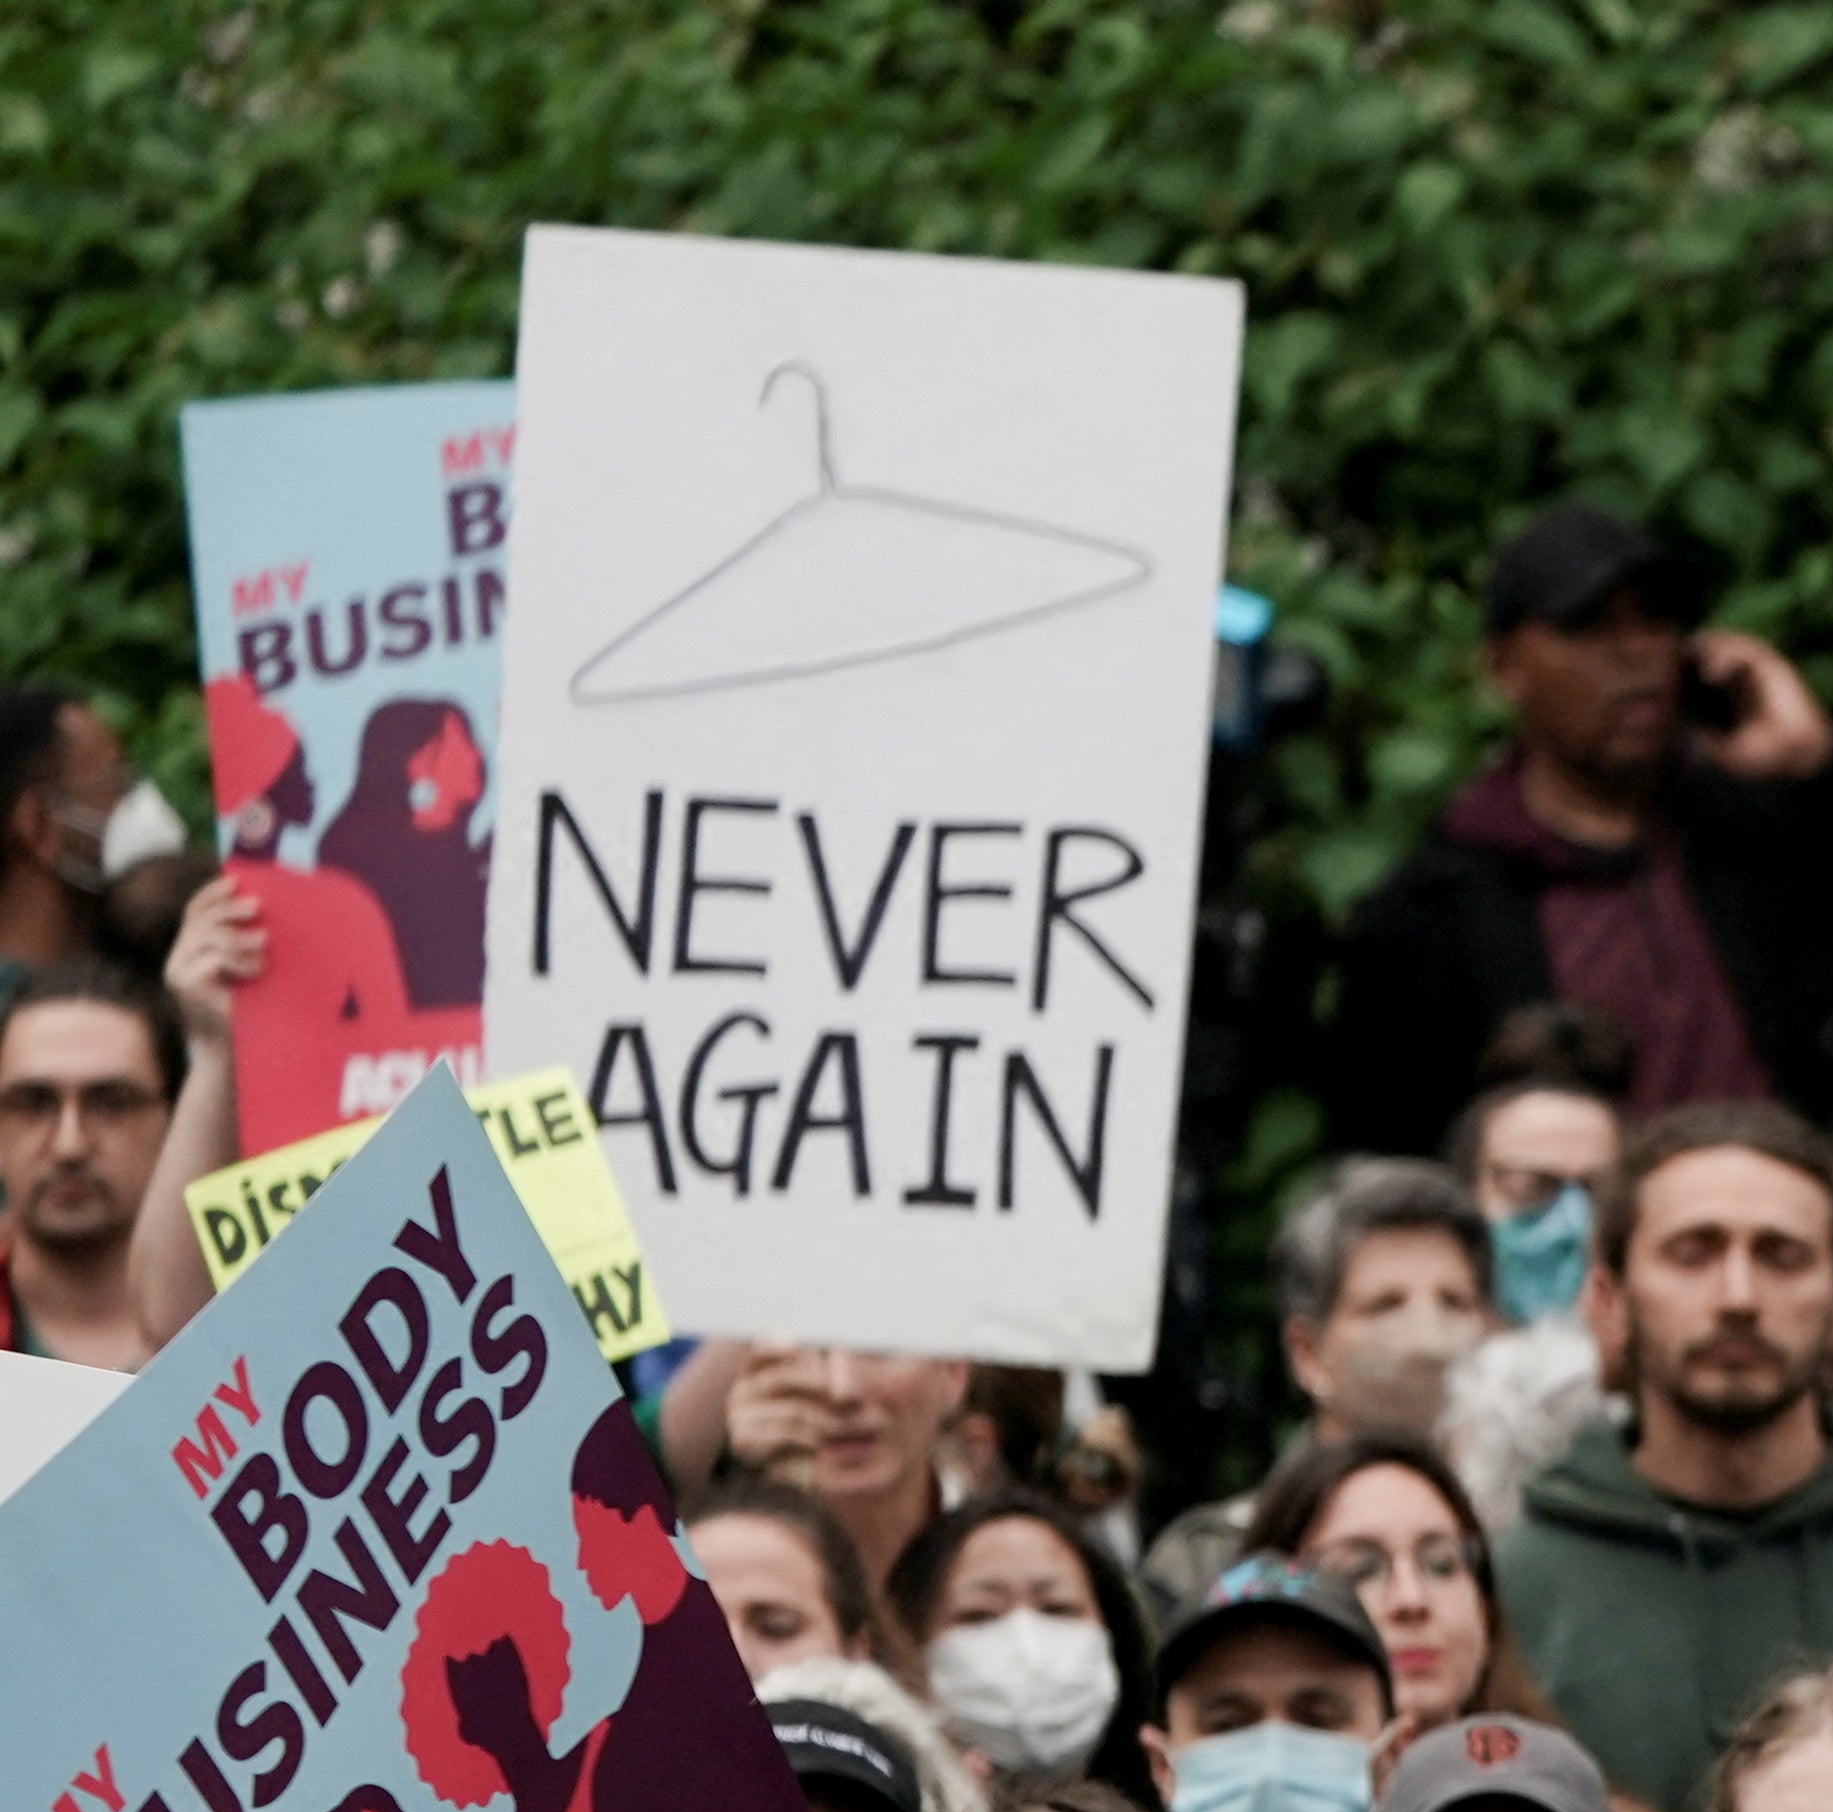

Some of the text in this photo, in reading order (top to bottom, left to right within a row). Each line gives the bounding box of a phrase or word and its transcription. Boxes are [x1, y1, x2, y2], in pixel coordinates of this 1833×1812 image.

[231, 559, 311, 618] MY
[533, 788, 1155, 1013] NEVER
[588, 1012, 1115, 1223] AGAIN
[171, 1356, 262, 1499] MY
[211, 1162, 477, 1605] BODY
